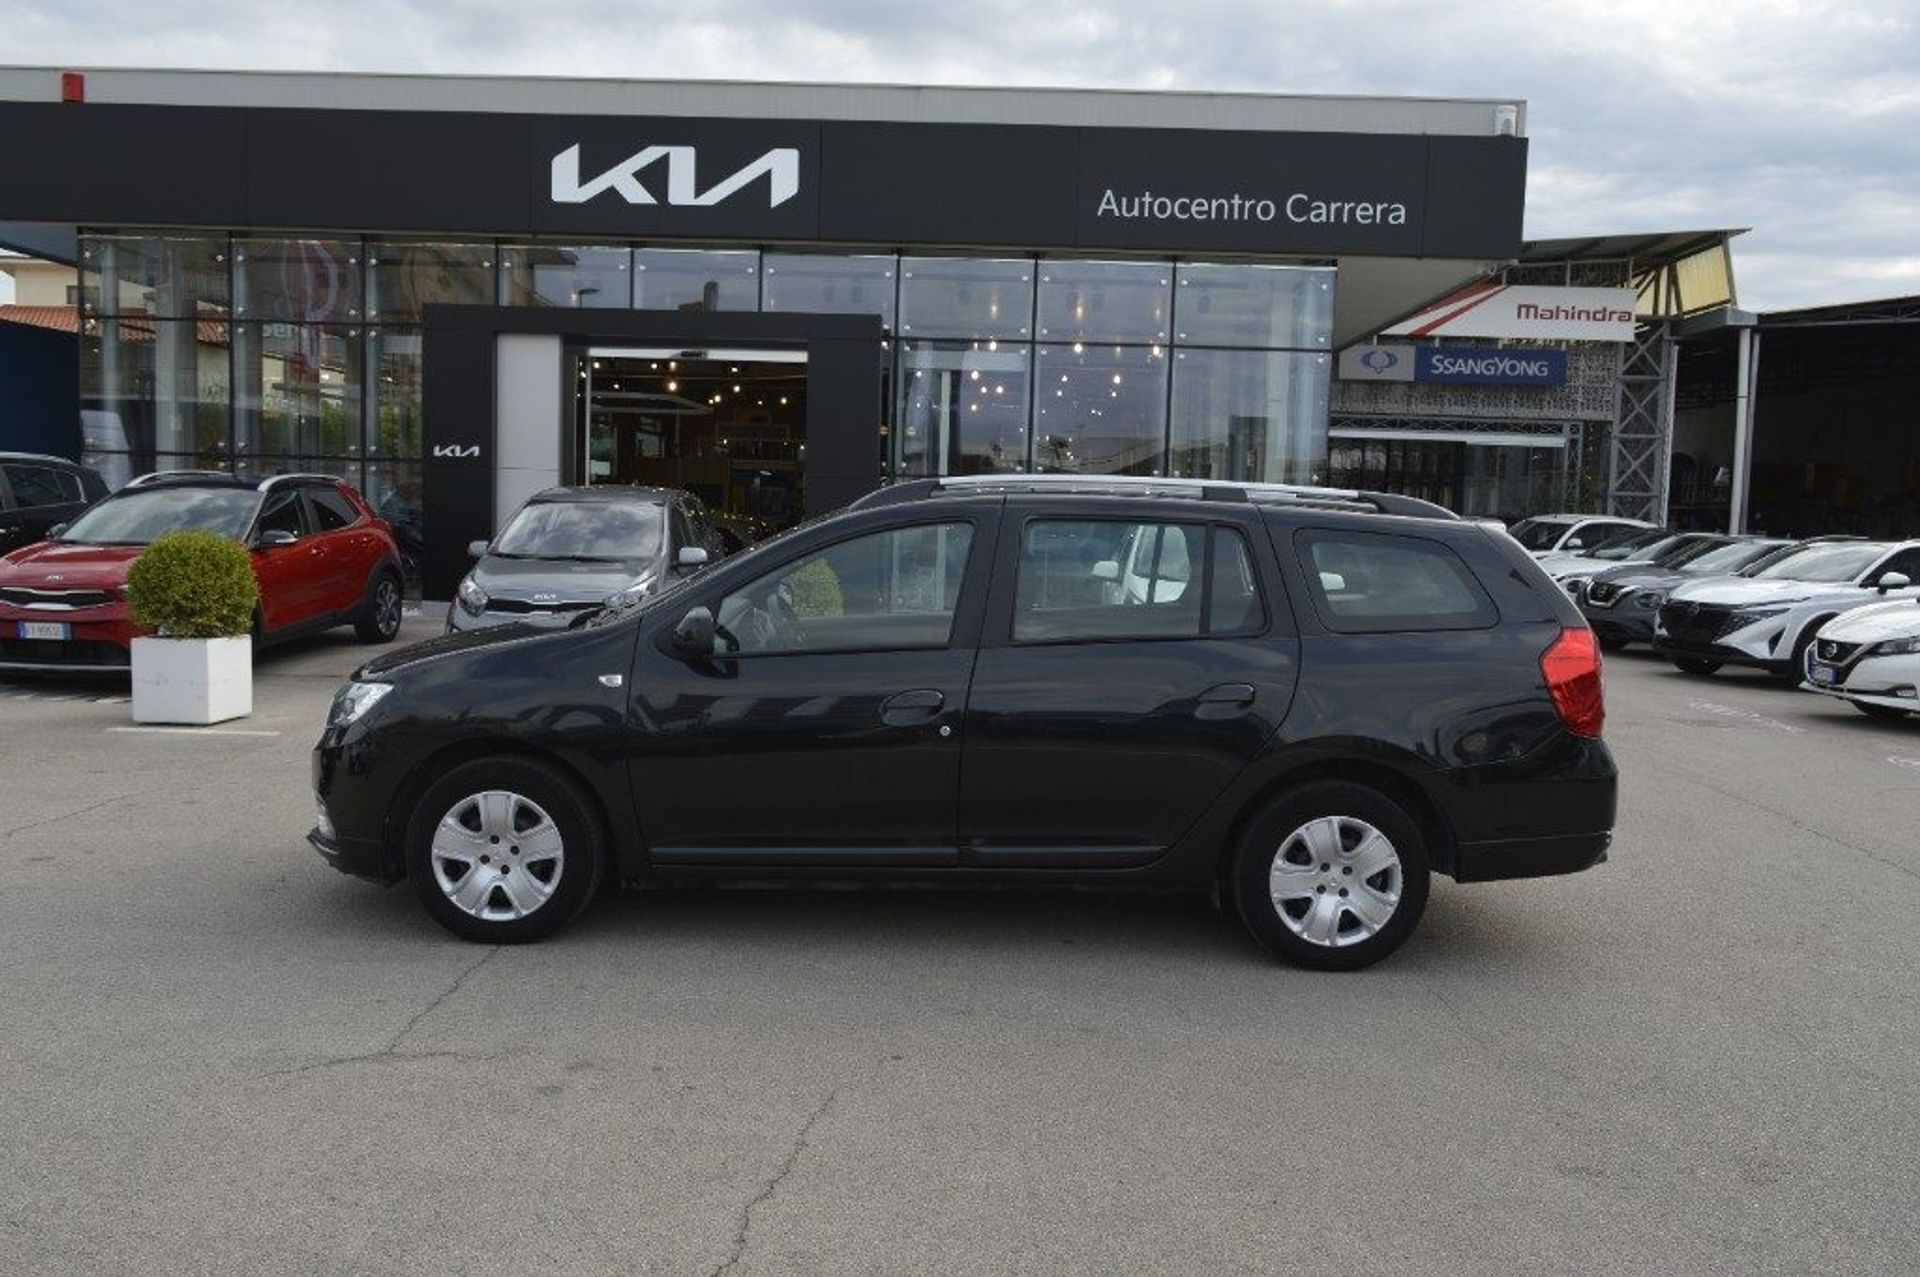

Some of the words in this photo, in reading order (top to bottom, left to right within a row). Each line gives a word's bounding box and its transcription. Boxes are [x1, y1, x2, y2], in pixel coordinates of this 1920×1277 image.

[551, 143, 799, 208] KIA
[1097, 189, 1275, 221] Autocentro
[1286, 194, 1406, 225] Carrera
[1517, 304, 1632, 322] Mahindra
[433, 444, 480, 457] KIA
